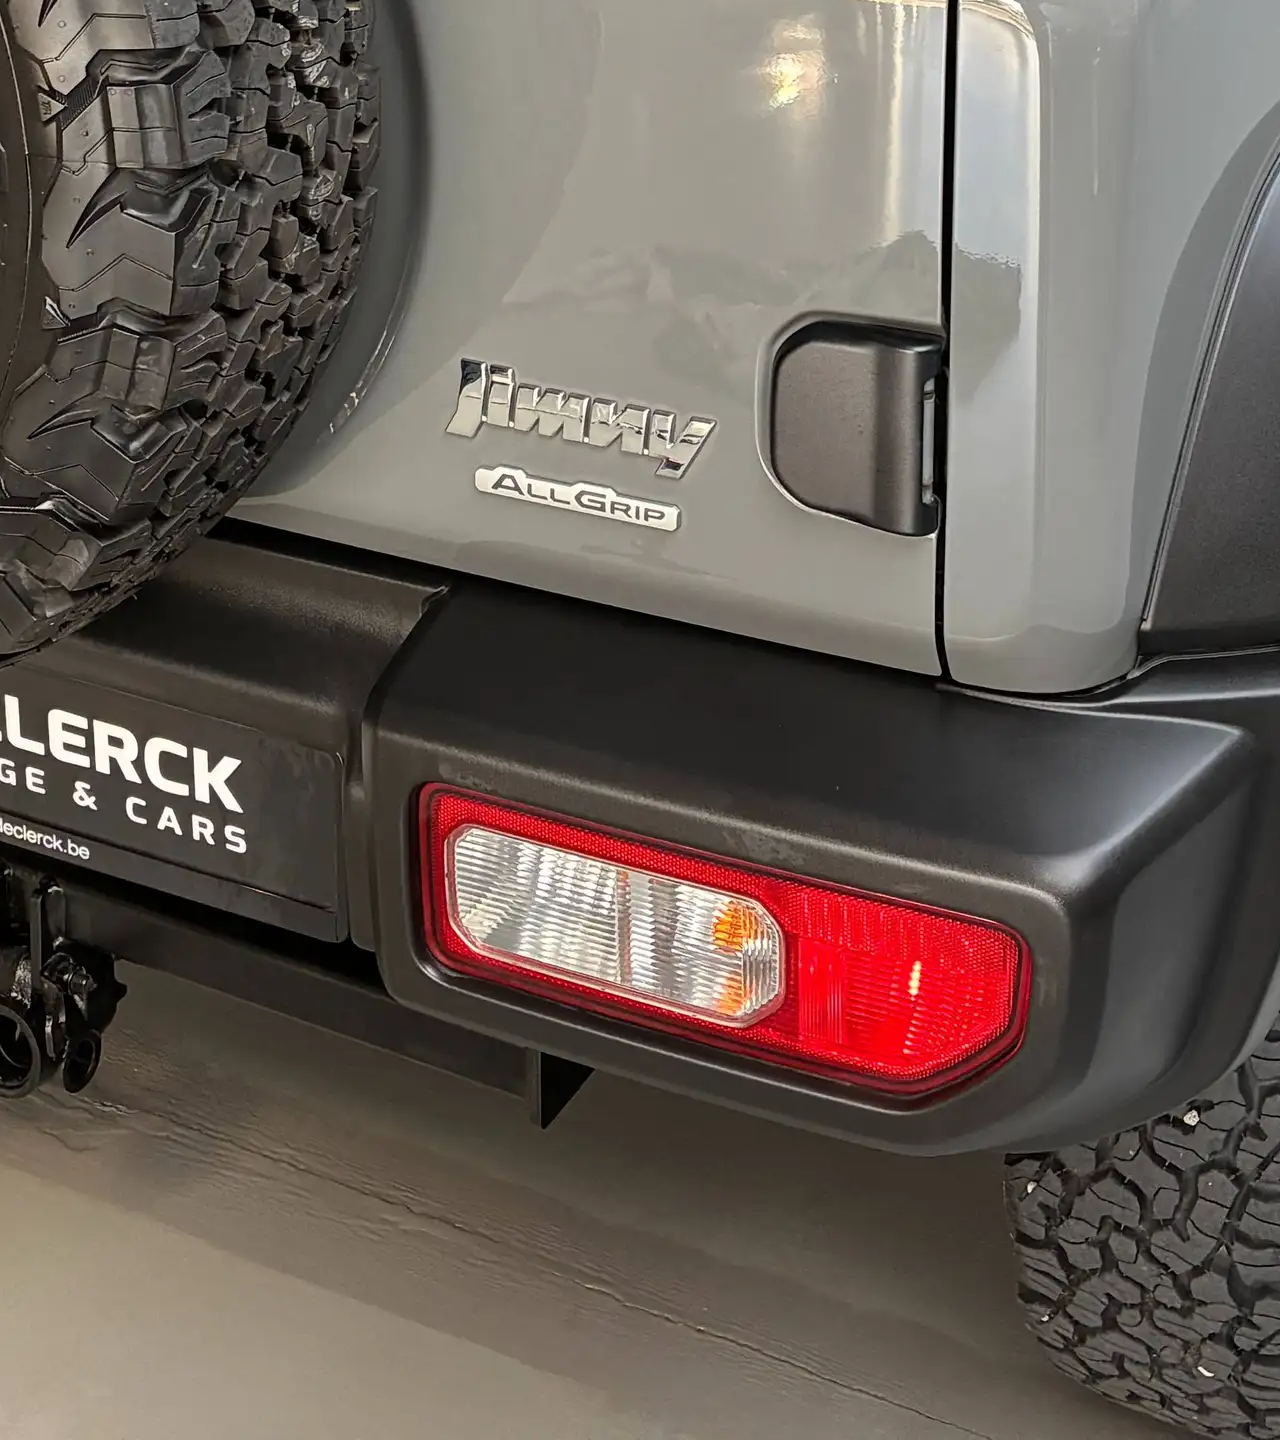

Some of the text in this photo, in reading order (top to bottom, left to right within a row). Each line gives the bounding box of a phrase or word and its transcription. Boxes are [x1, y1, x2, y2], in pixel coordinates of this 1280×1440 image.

[445, 357, 718, 480] Jimny
[71, 780, 99, 811] &
[124, 795, 248, 855] CARS
